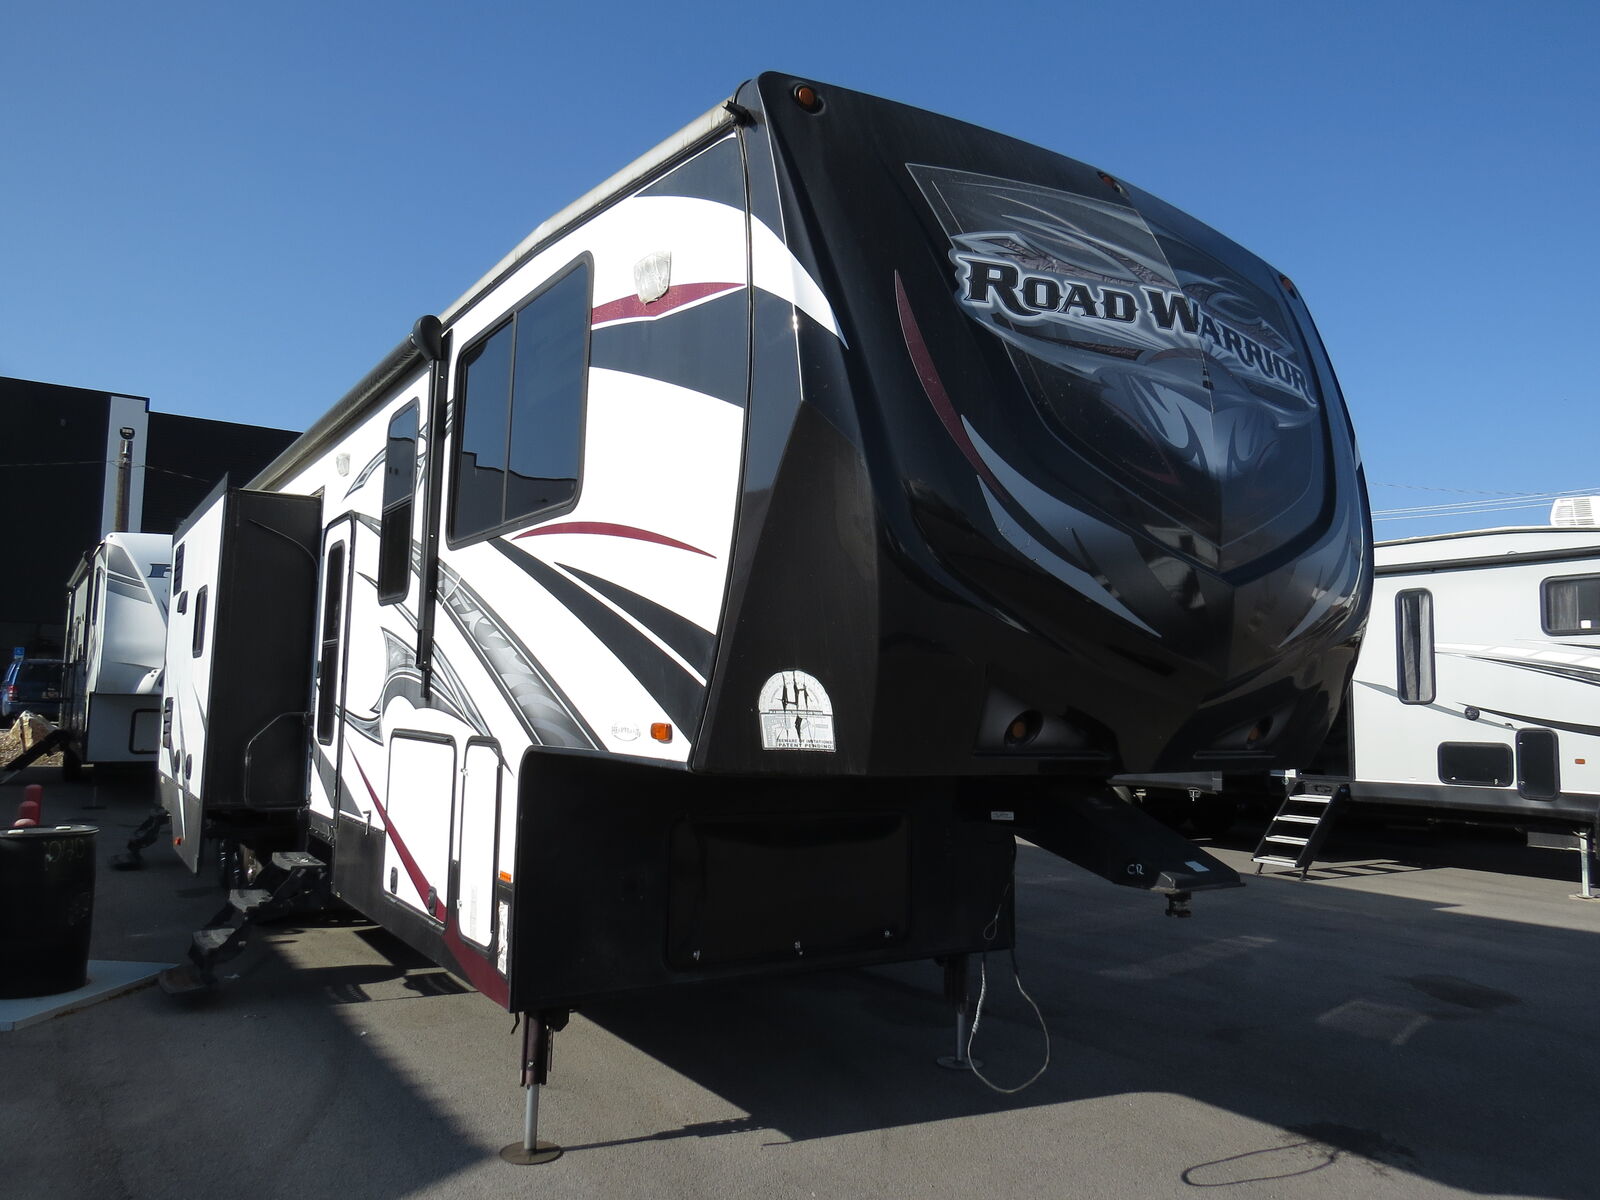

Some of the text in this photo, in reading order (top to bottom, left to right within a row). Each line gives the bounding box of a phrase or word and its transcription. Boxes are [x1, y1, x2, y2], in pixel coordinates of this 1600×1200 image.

[965, 259, 1316, 405] ROAD WARRIOR
[1127, 863, 1145, 875] CR
